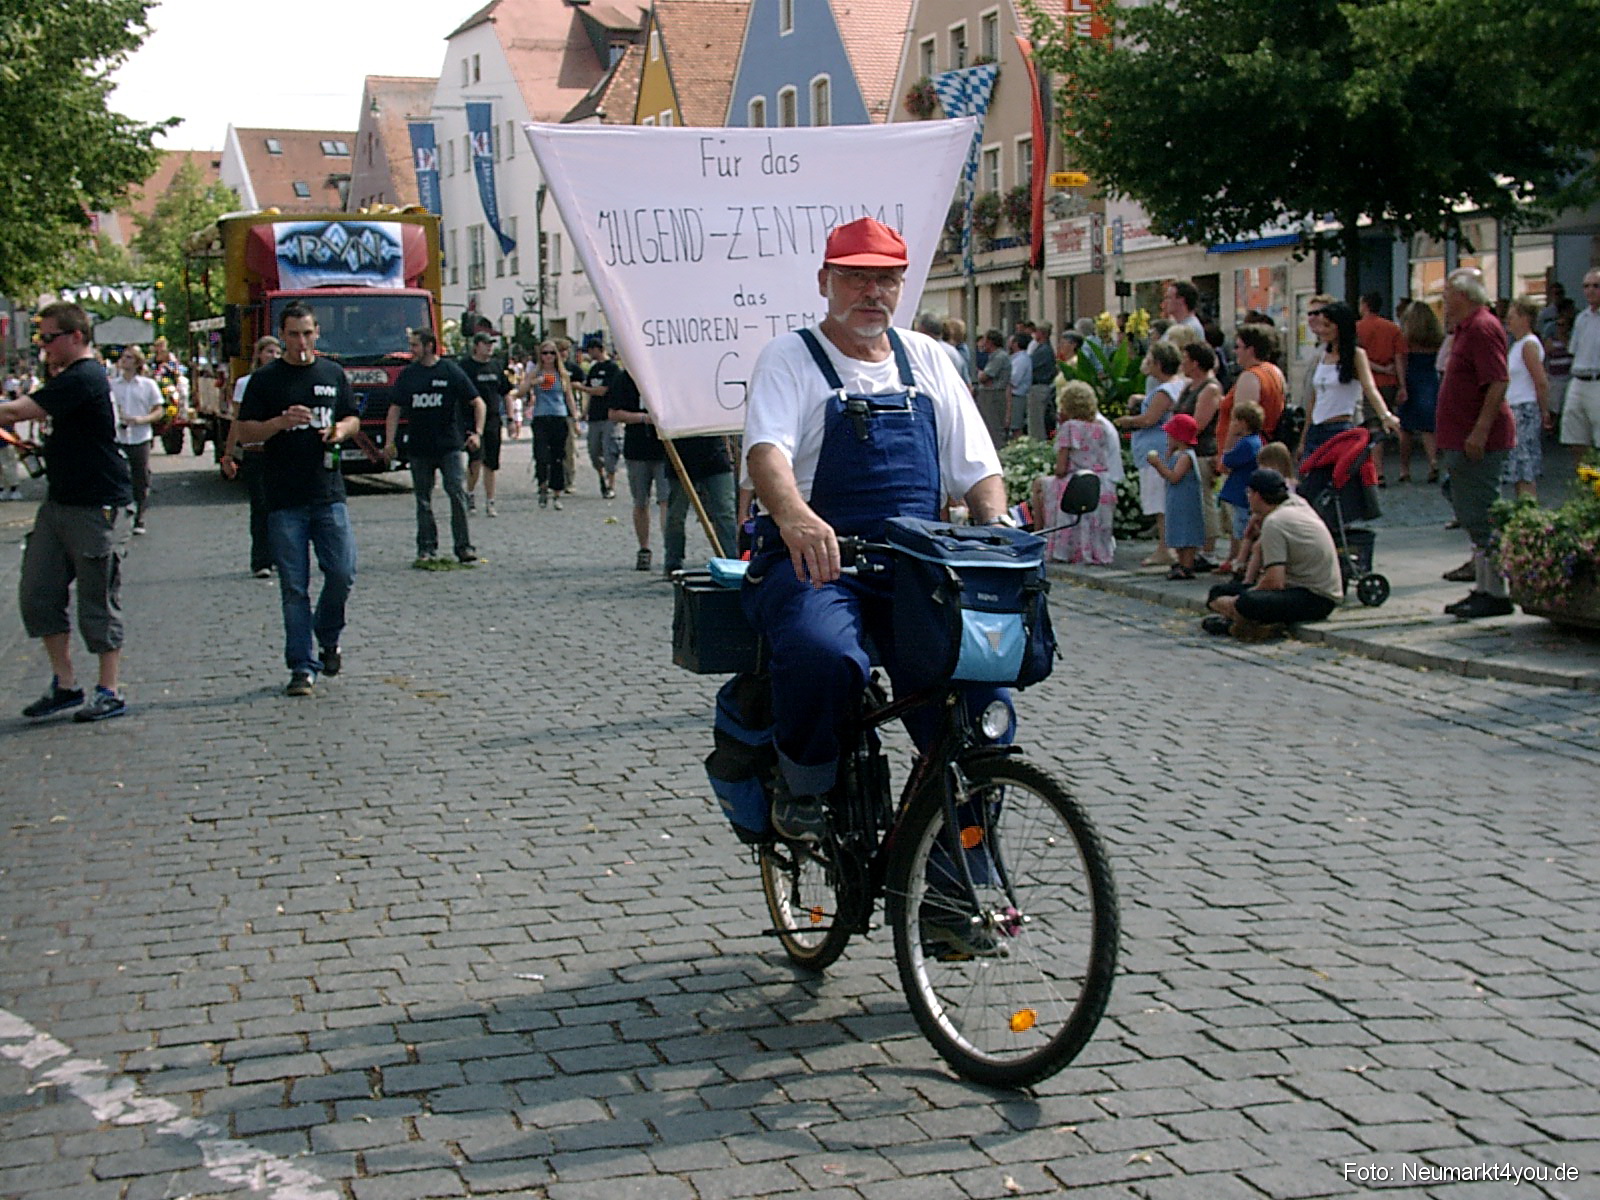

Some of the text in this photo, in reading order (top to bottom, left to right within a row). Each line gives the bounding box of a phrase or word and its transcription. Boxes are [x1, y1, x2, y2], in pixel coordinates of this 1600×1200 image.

[700, 136, 800, 178] Für das
[733, 284, 767, 307] das
[412, 393, 443, 408] ROCK
